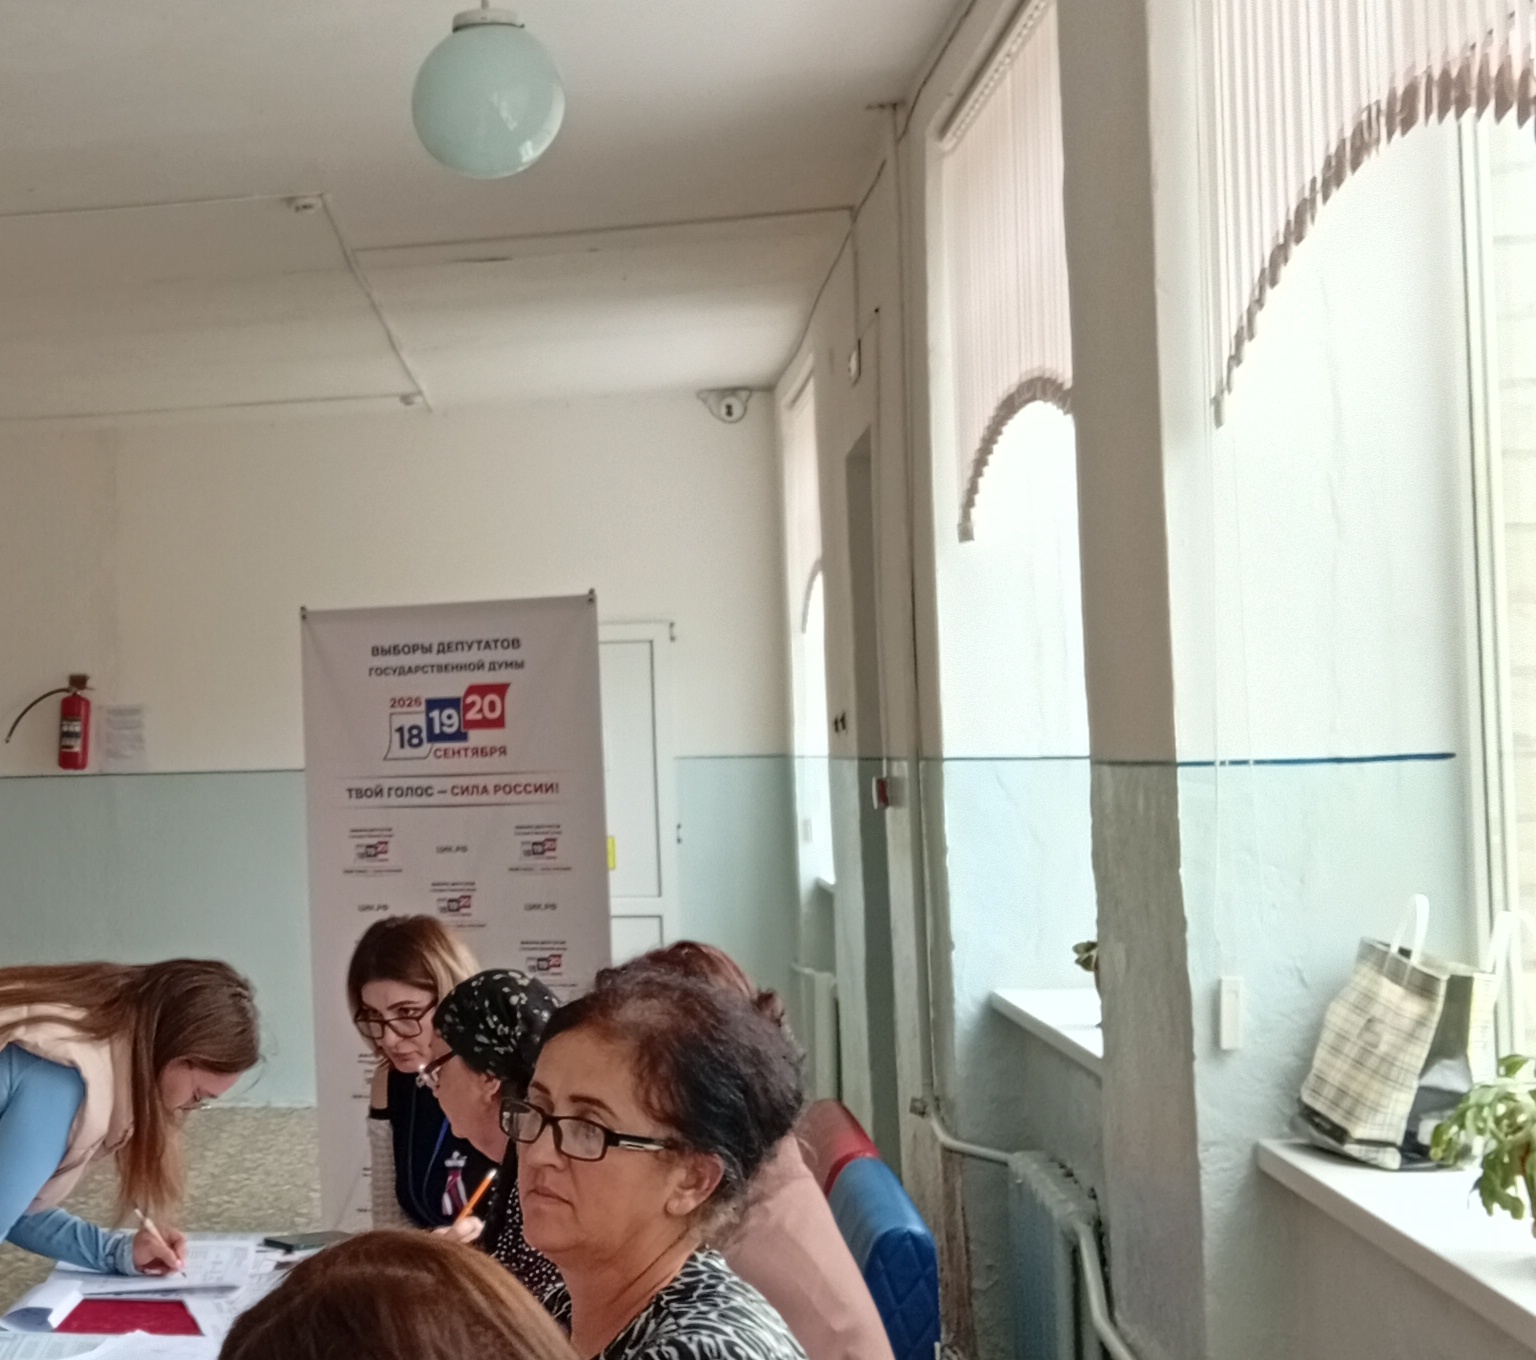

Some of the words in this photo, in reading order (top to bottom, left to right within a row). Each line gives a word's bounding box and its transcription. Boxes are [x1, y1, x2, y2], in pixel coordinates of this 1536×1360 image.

[371, 643, 433, 657] ВЫБОРЫ
[436, 638, 521, 655] ДЕПУТАТОВ
[368, 659, 485, 677] ГОСУДАРСТВЕННОЙ
[488, 660, 525, 672] ДУМЫ
[390, 696, 422, 709] 2026
[394, 724, 424, 750] 18
[428, 707, 459, 734] 19
[465, 693, 502, 720] 20
[433, 745, 508, 759] СЕНТЯБРЯ
[347, 784, 383, 799] ТВОЙ
[387, 785, 434, 798] ГОЛОС
[450, 784, 489, 796] СИЛА
[493, 782, 559, 796] РОССИИ!
